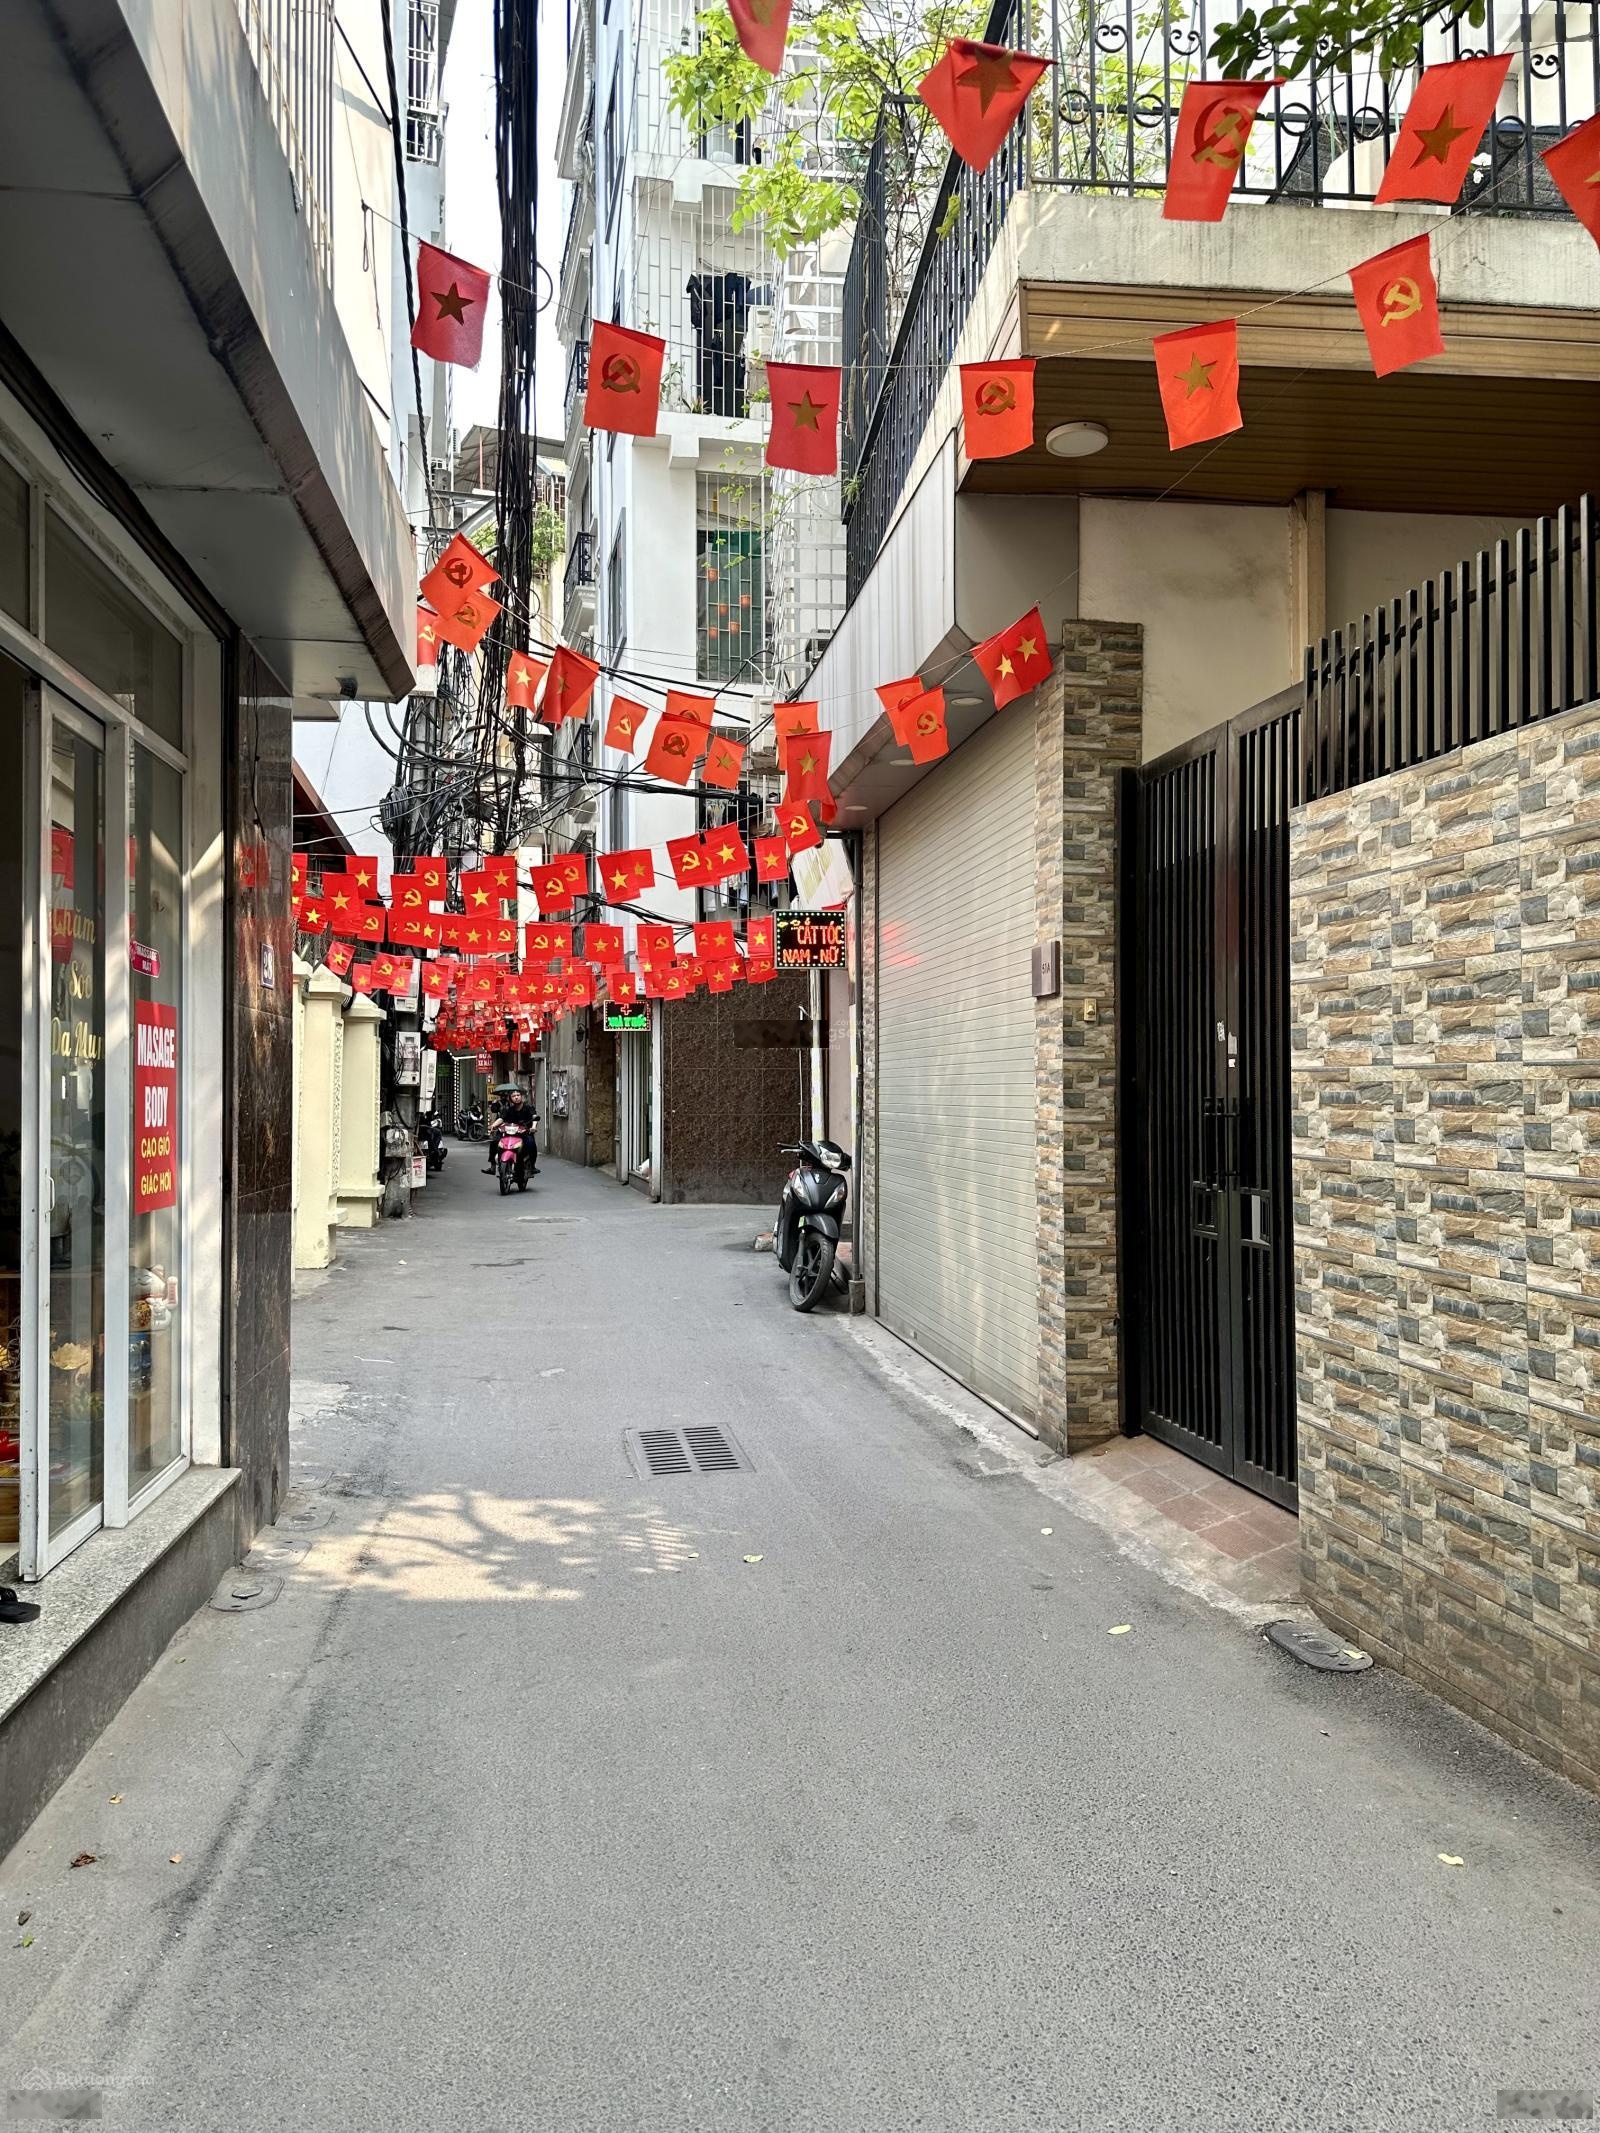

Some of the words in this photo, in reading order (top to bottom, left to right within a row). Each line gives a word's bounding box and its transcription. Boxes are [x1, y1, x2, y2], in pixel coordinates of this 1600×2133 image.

[797, 917, 819, 944] CẮT
[820, 920, 843, 944] TÓC
[263, 951, 273, 980] 28
[783, 948, 810, 963] NAM
[820, 946, 840, 963] NỮ
[137, 1023, 175, 1069] MASAGE
[144, 1086, 169, 1128] BODY
[141, 1137, 157, 1164] CẠO
[157, 1131, 170, 1156] GIÓ
[140, 1168, 159, 1196] GIÁC
[159, 1168, 172, 1192] HƠI
